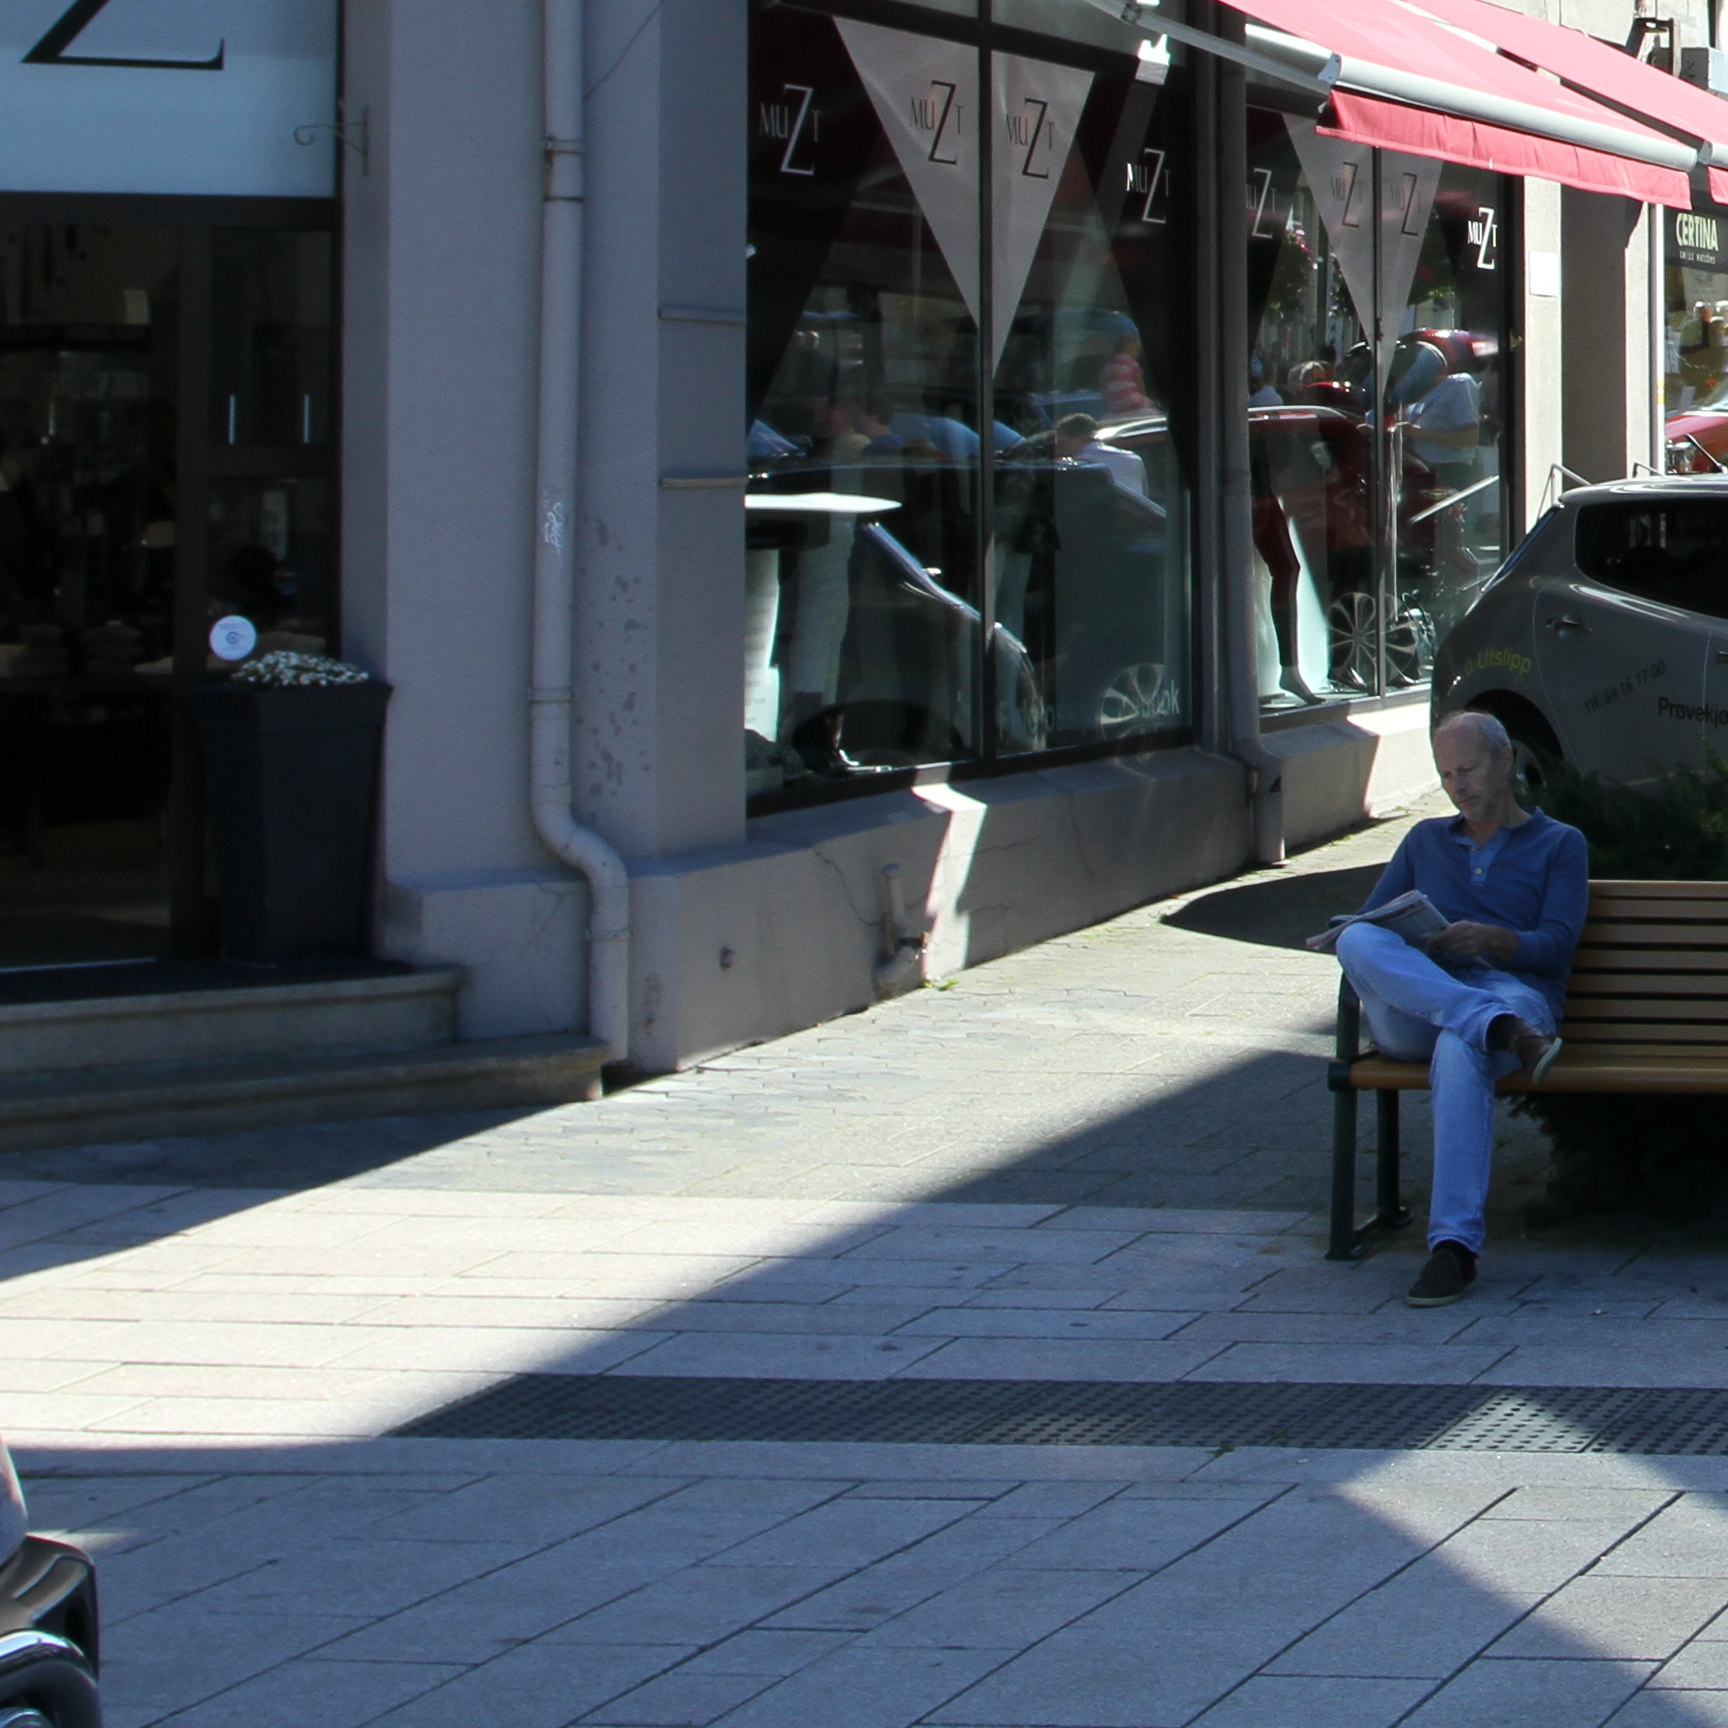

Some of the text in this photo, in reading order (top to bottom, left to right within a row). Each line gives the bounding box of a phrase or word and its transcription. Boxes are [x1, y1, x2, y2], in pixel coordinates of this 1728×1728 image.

[1676, 212, 1719, 252] CERTINA
[1478, 649, 1532, 675] Utslipp
[1604, 689, 1618, 704] 69
[1651, 661, 1666, 677] 00
